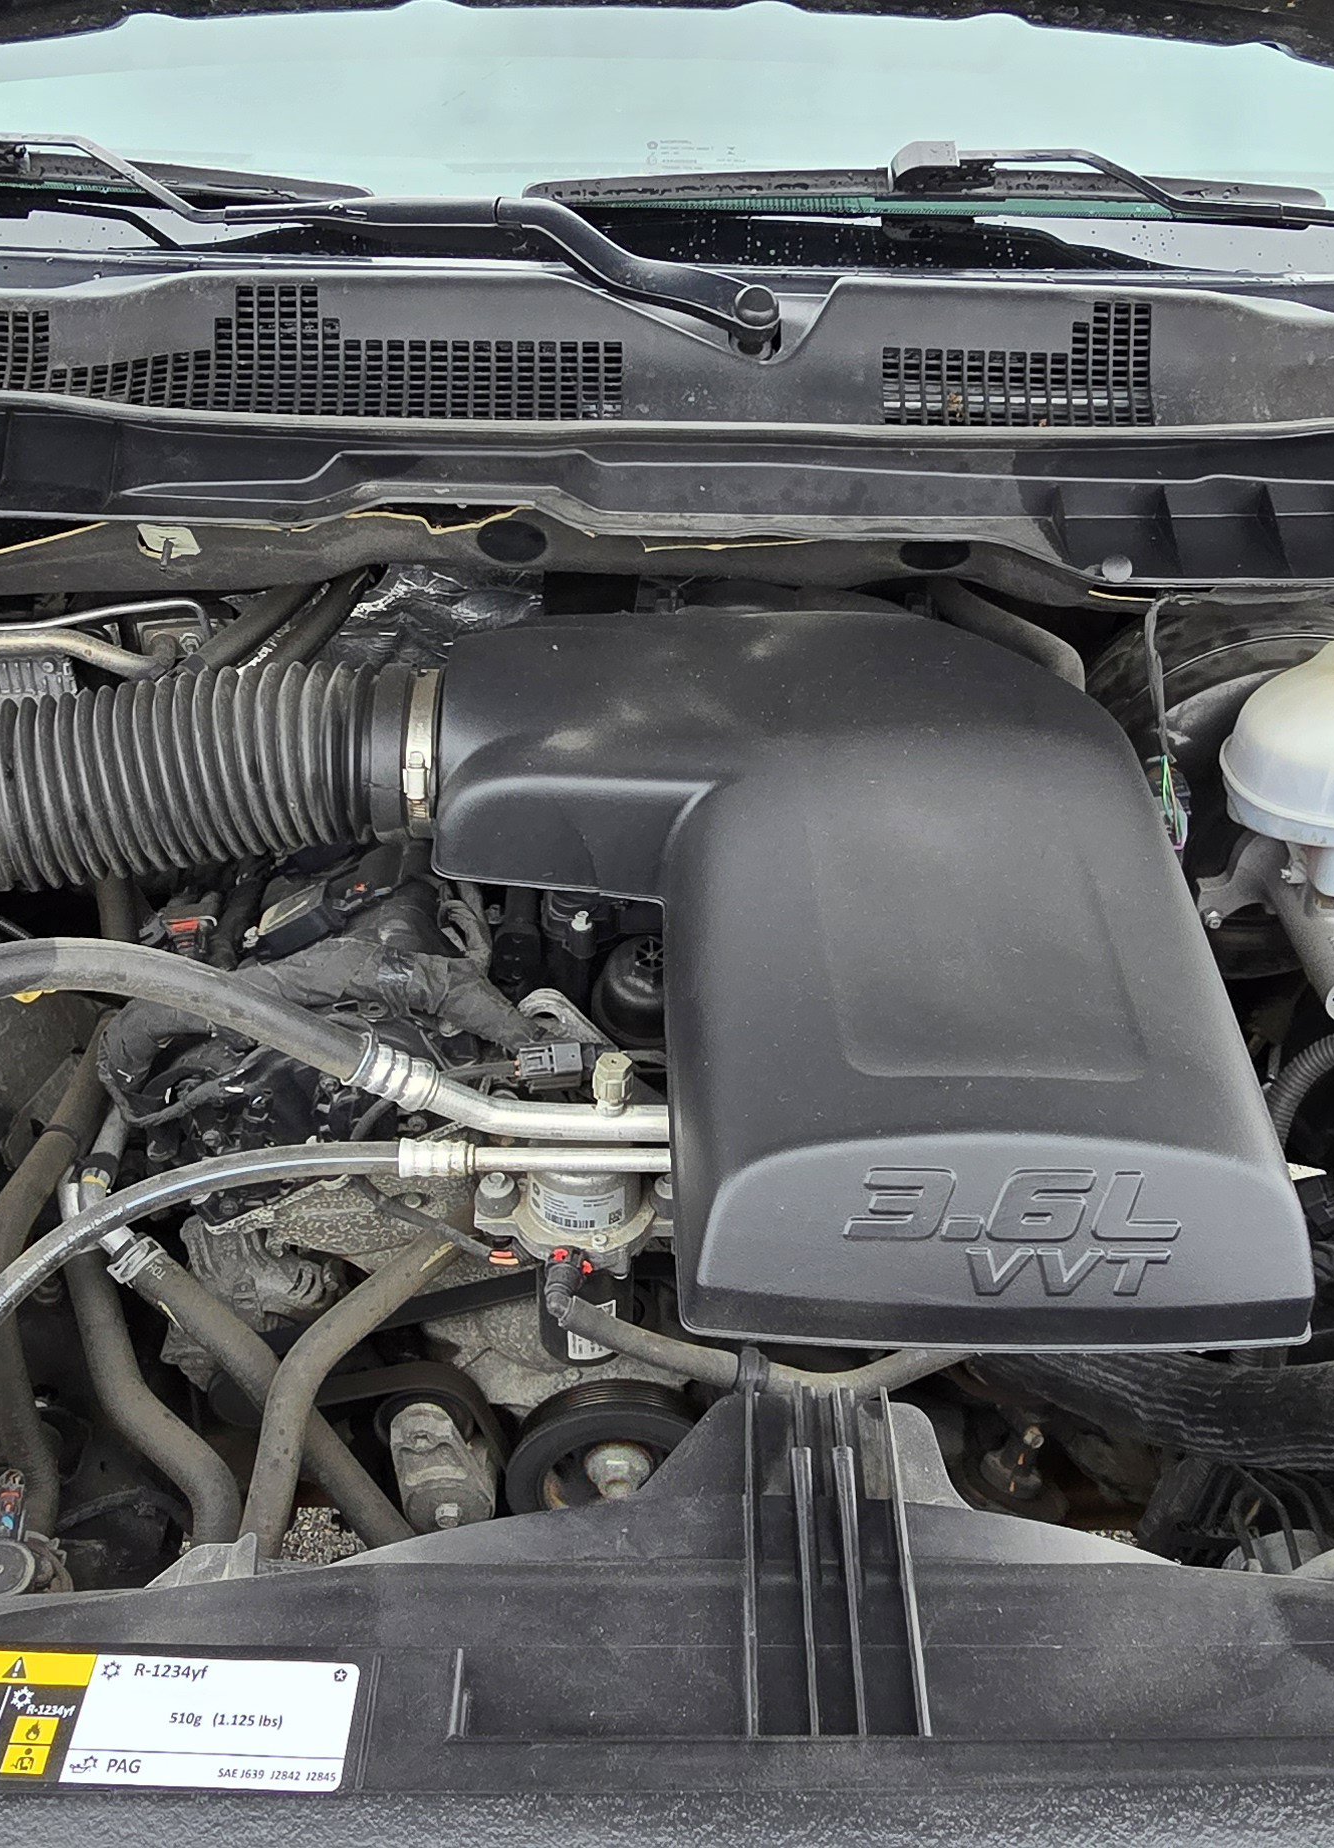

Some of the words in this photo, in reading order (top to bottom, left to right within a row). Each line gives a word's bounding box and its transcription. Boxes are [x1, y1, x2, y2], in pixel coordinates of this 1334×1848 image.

[842, 1165, 1182, 1242] 3.6L
[965, 1246, 1172, 1296] VVT
[134, 1661, 209, 1682] R-1234yf
[26, 1704, 76, 1719] R-1234yf
[169, 1711, 202, 1730] 510g
[212, 1711, 256, 1730] (1.125
[258, 1712, 283, 1731] lbs)
[106, 1758, 142, 1774] PAG
[217, 1767, 238, 1779] SAE
[240, 1768, 265, 1780] J639
[270, 1770, 301, 1781] J2842
[306, 1771, 336, 1782] J2845
